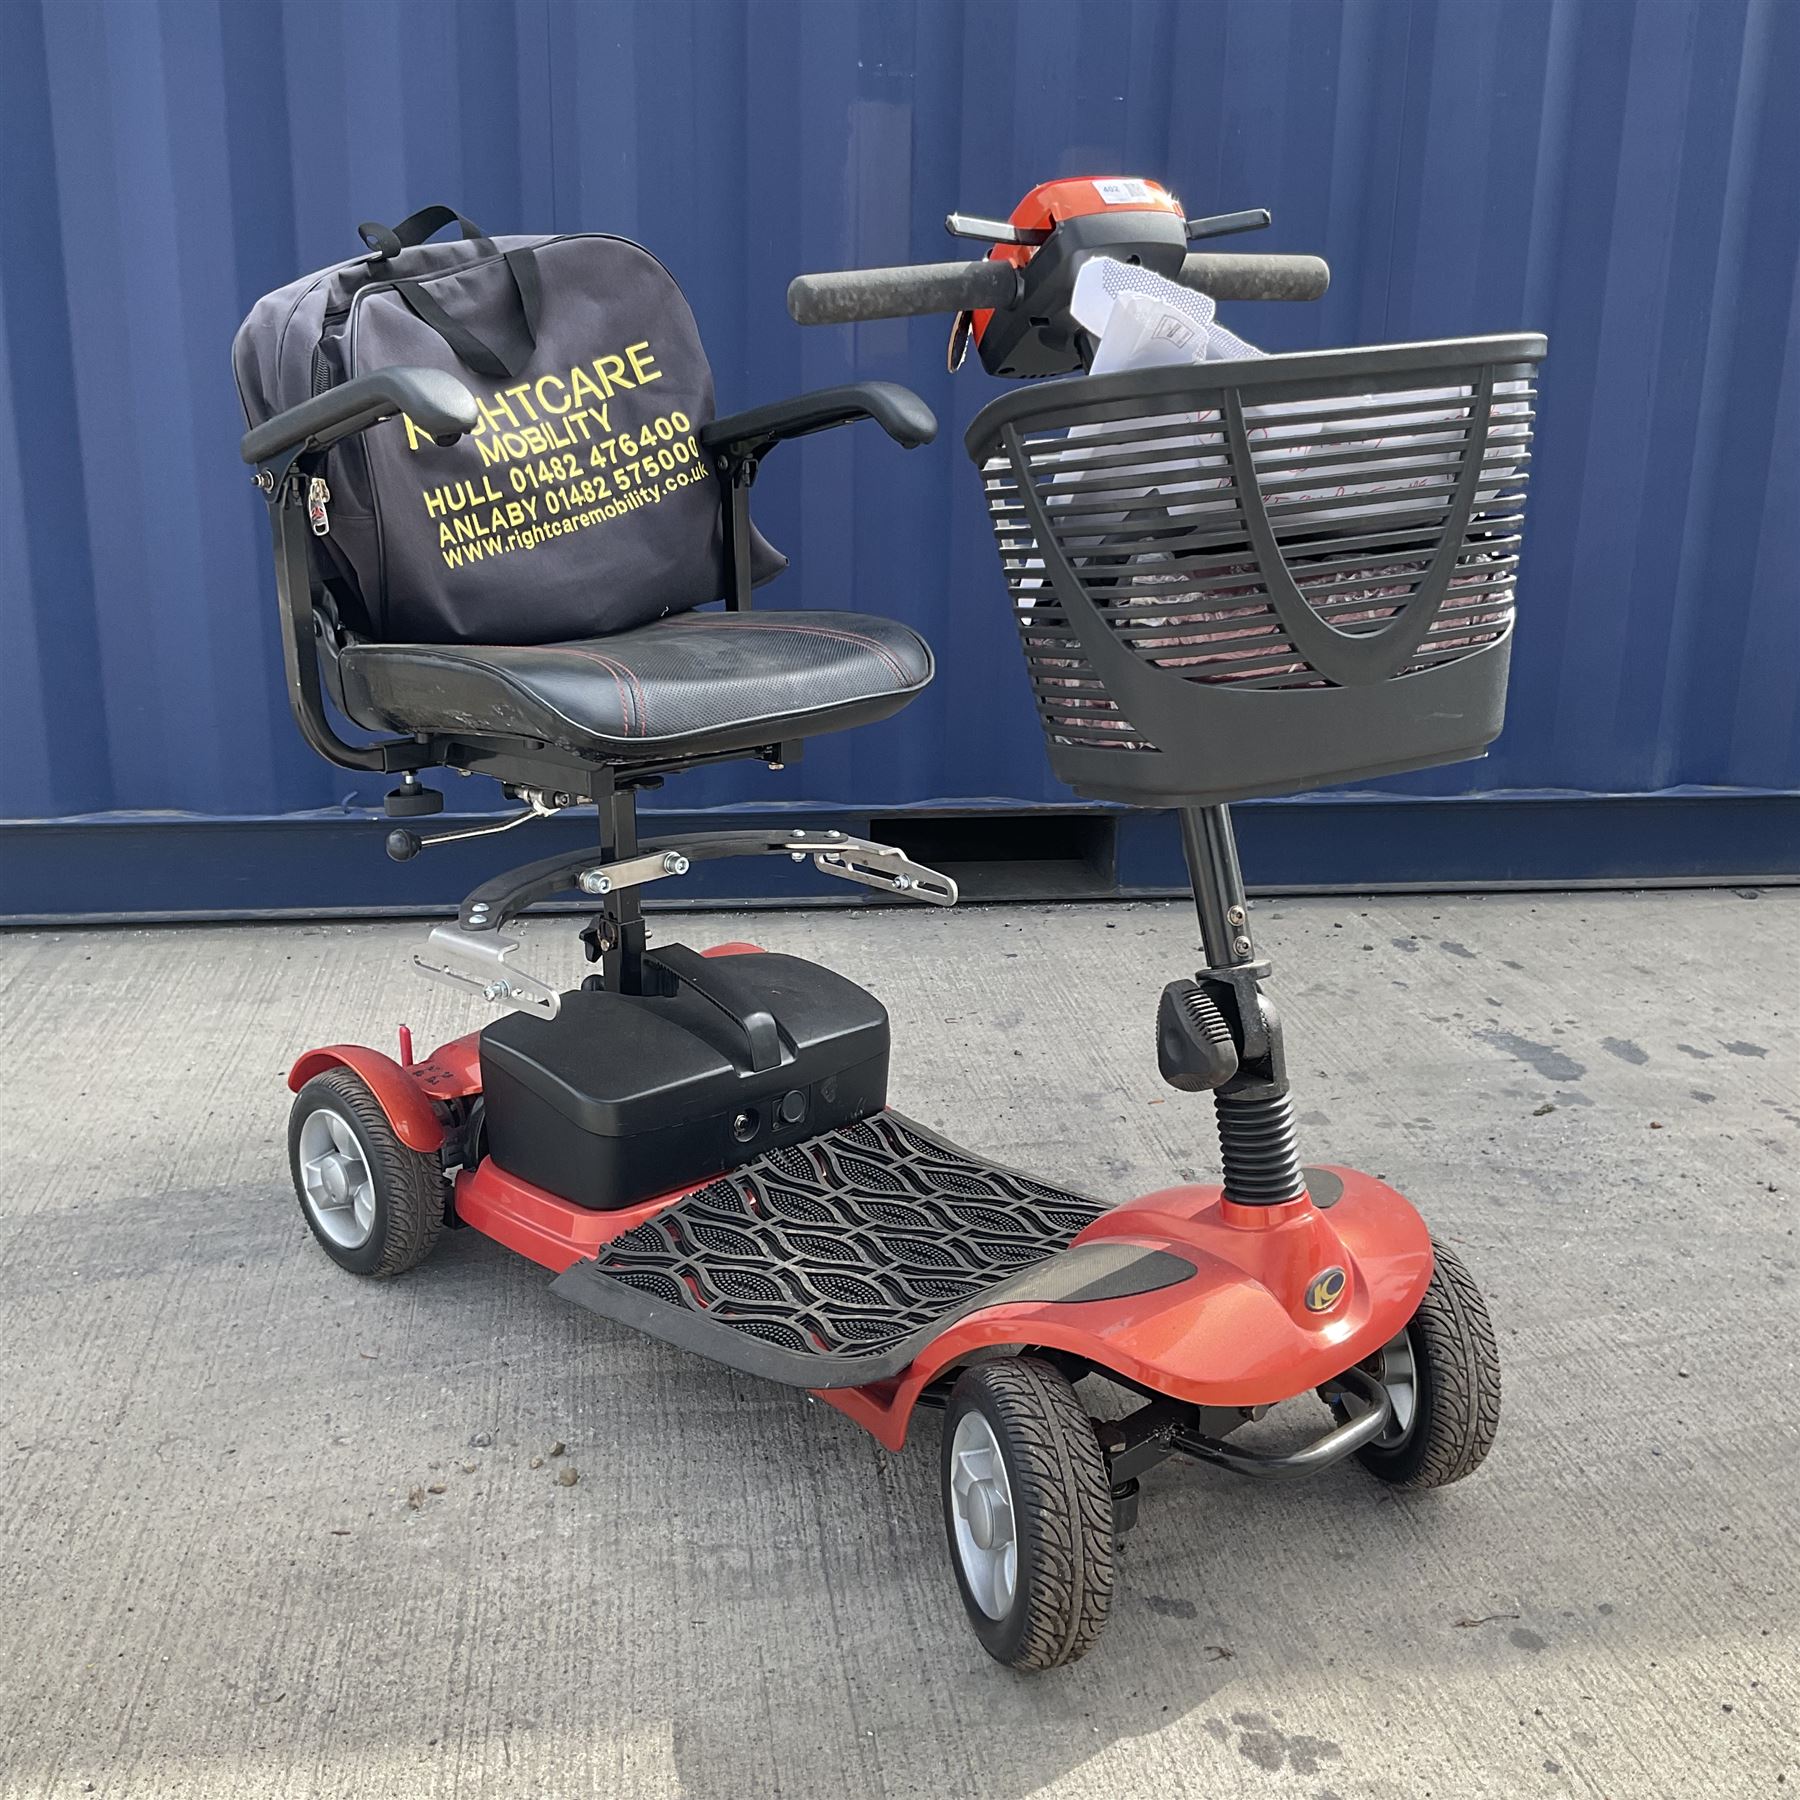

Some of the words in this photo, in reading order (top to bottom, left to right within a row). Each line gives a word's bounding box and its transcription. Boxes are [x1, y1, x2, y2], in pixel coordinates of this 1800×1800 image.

[404, 341, 663, 450] HTCARE
[475, 403, 612, 467] MOBILITY
[423, 476, 503, 518] HULL
[510, 452, 584, 494] 01482
[439, 496, 538, 548] ANLABY
[545, 476, 613, 515] 01482
[612, 436, 699, 492] 575000
